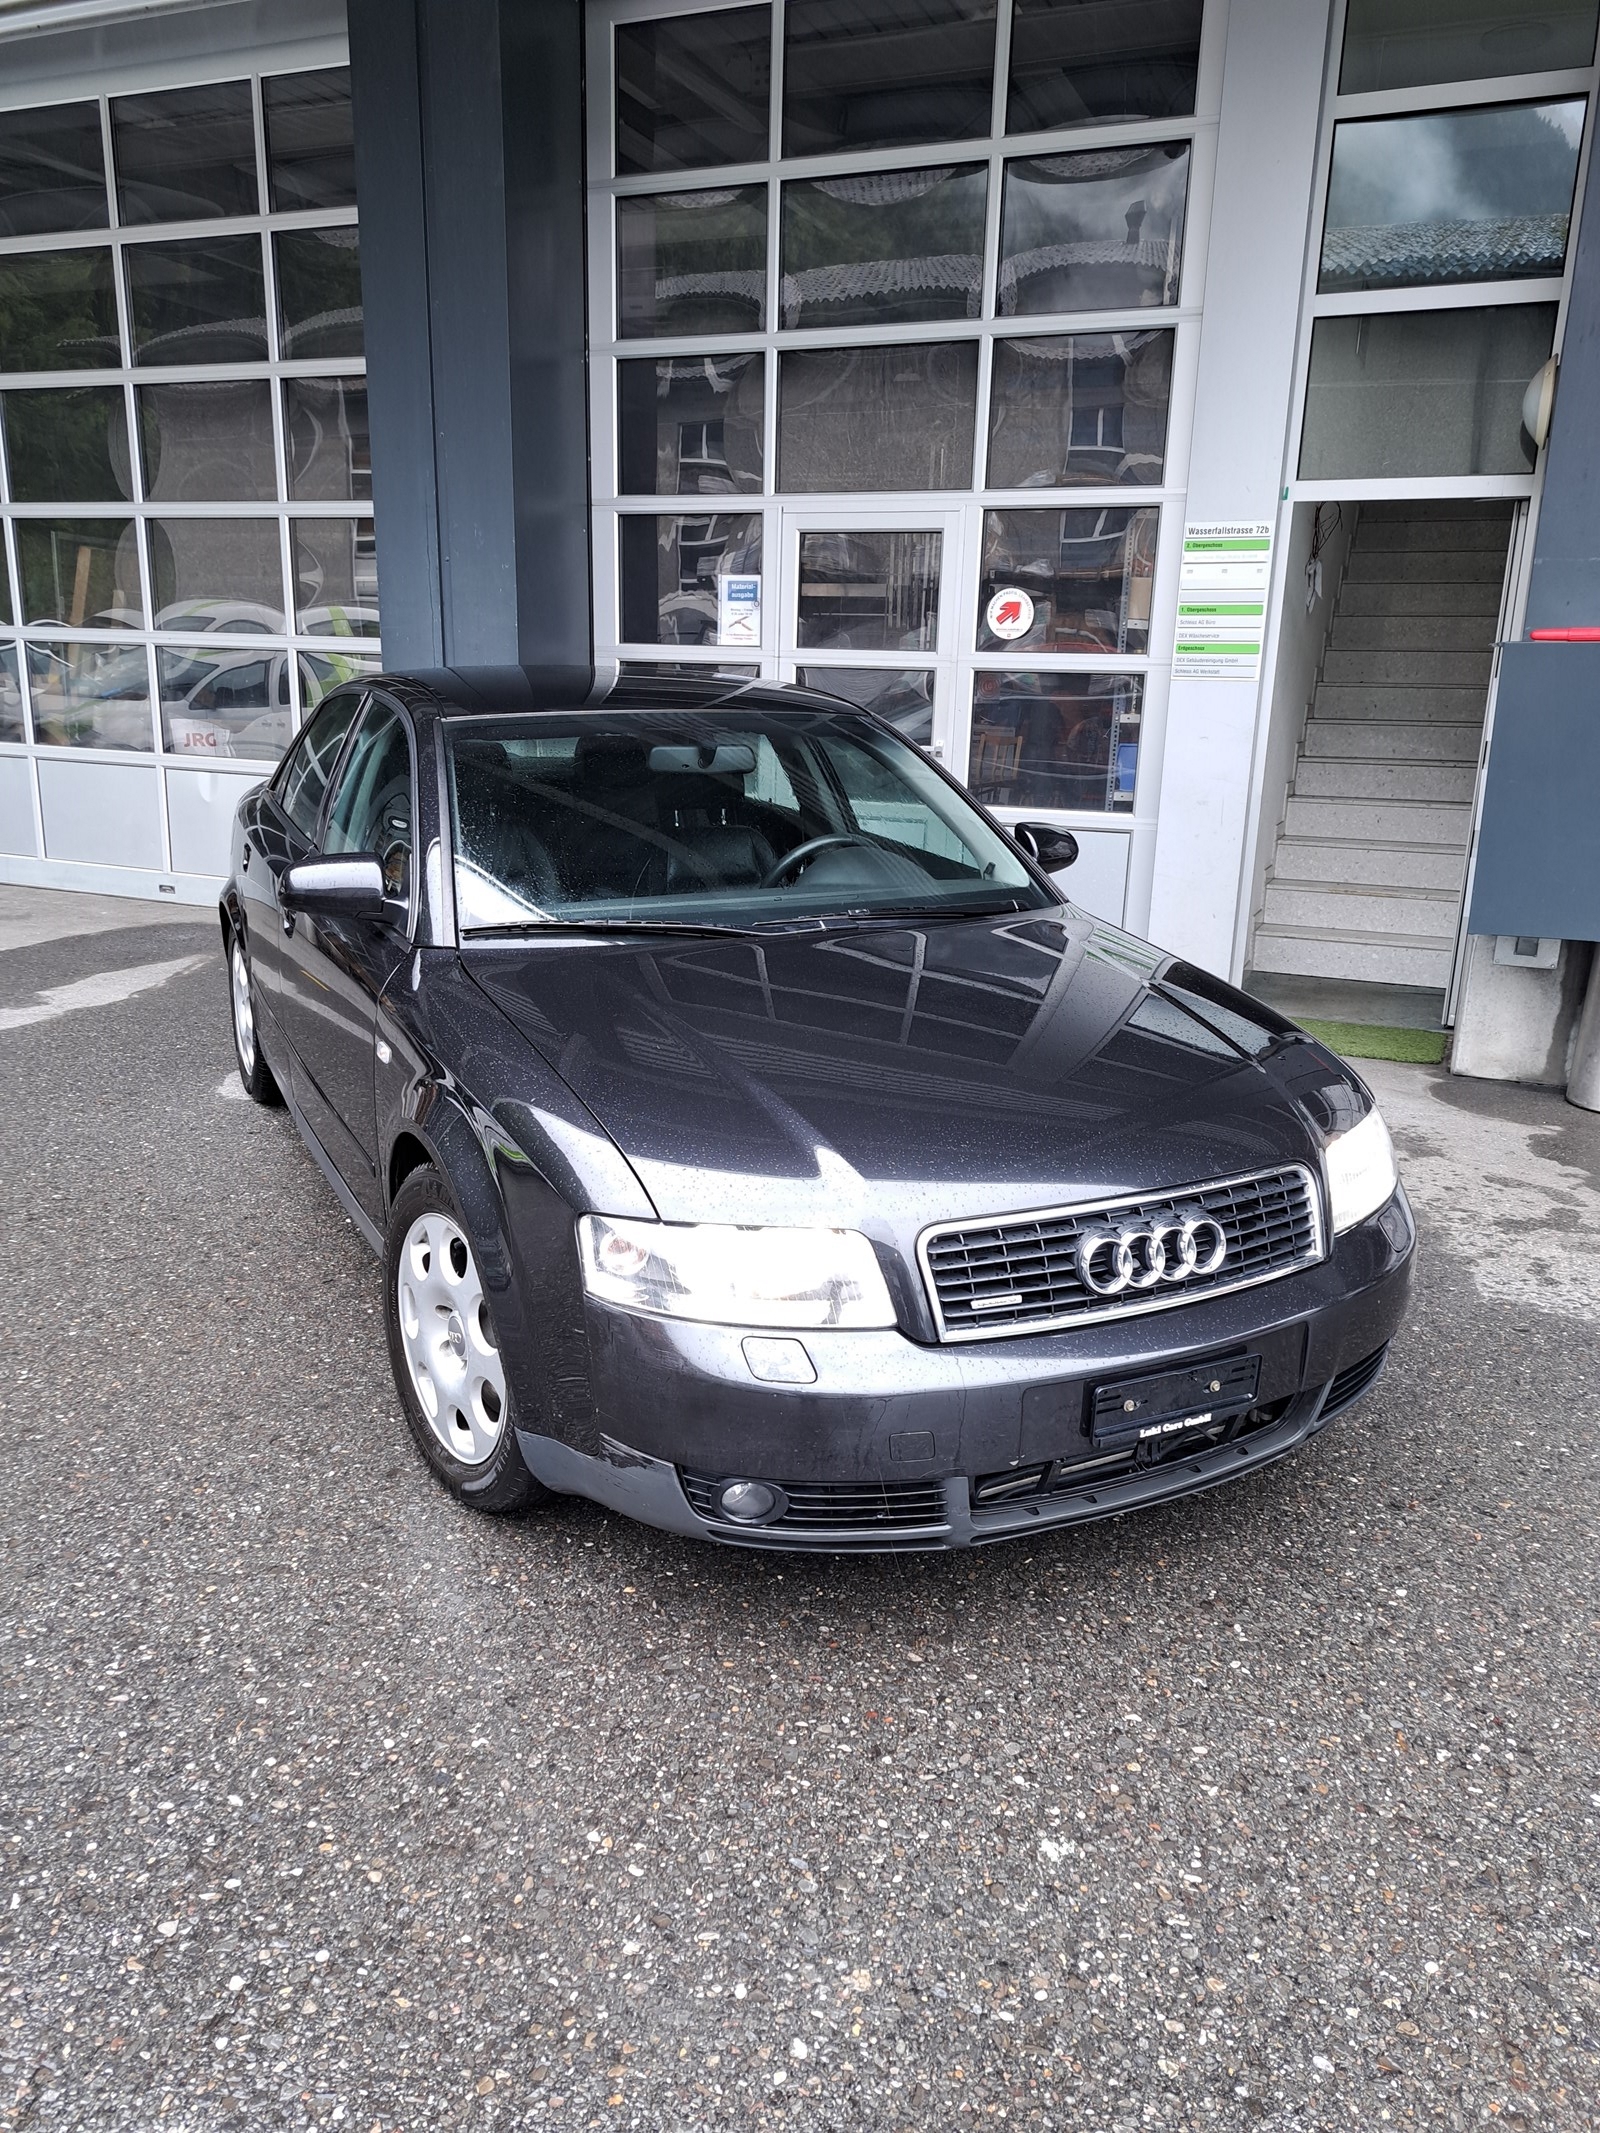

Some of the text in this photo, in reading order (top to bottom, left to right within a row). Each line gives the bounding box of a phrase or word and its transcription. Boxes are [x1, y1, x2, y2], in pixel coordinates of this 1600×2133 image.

[1188, 525, 1270, 536] Wasserfallstrasse 72b
[183, 732, 217, 748] JRG
